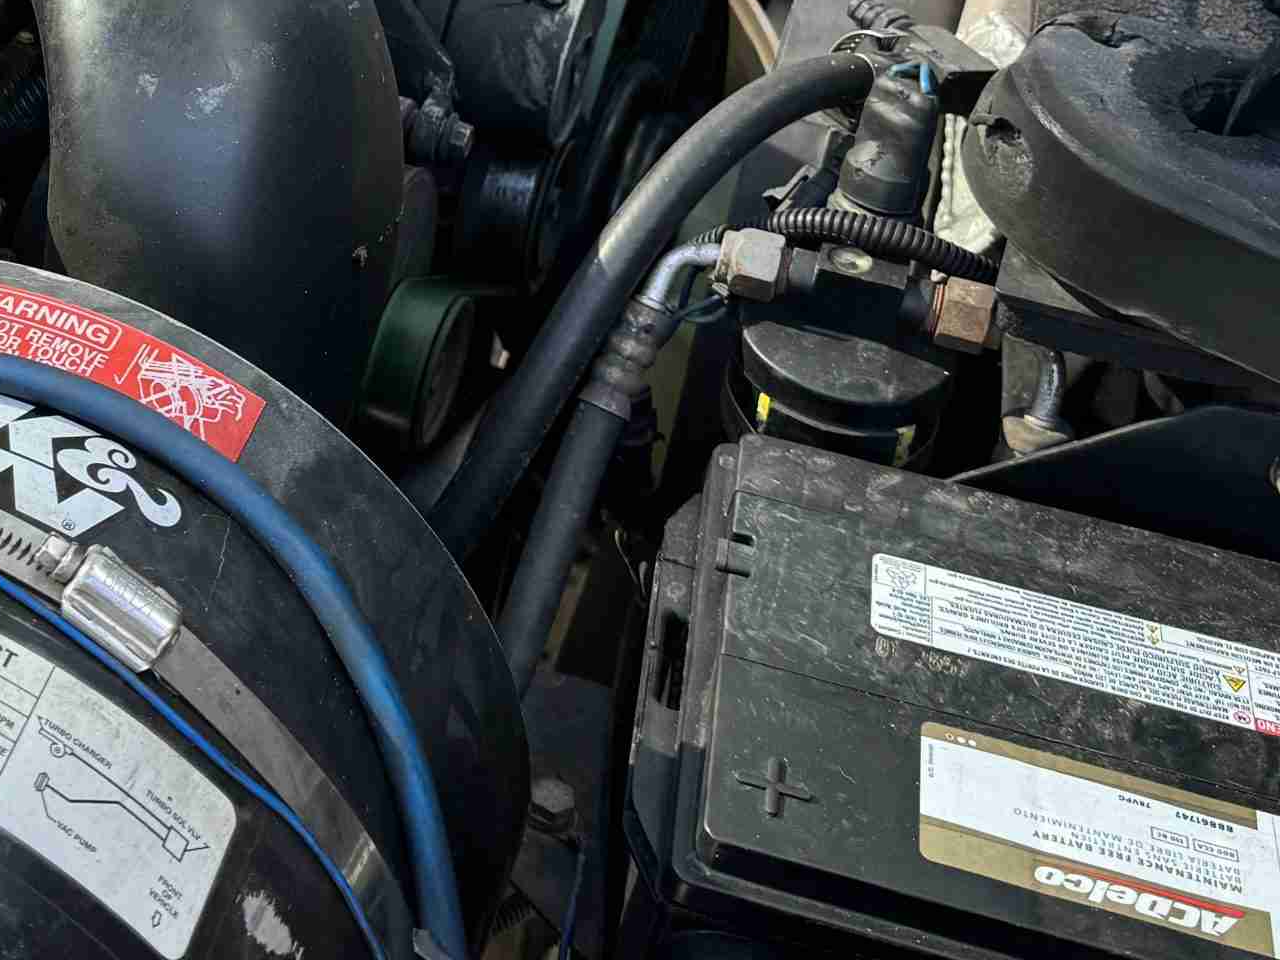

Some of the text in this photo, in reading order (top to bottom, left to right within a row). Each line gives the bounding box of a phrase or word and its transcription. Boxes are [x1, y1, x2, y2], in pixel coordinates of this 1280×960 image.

[26, 328, 109, 367] REMOVE
[27, 341, 95, 376] TOUCH
[145, 789, 173, 815] TURBO
[73, 833, 97, 854] PUMP
[1031, 828, 1242, 893] MAINTENANCE FREE BATTERY
[1033, 865, 1246, 937] ACDelco
